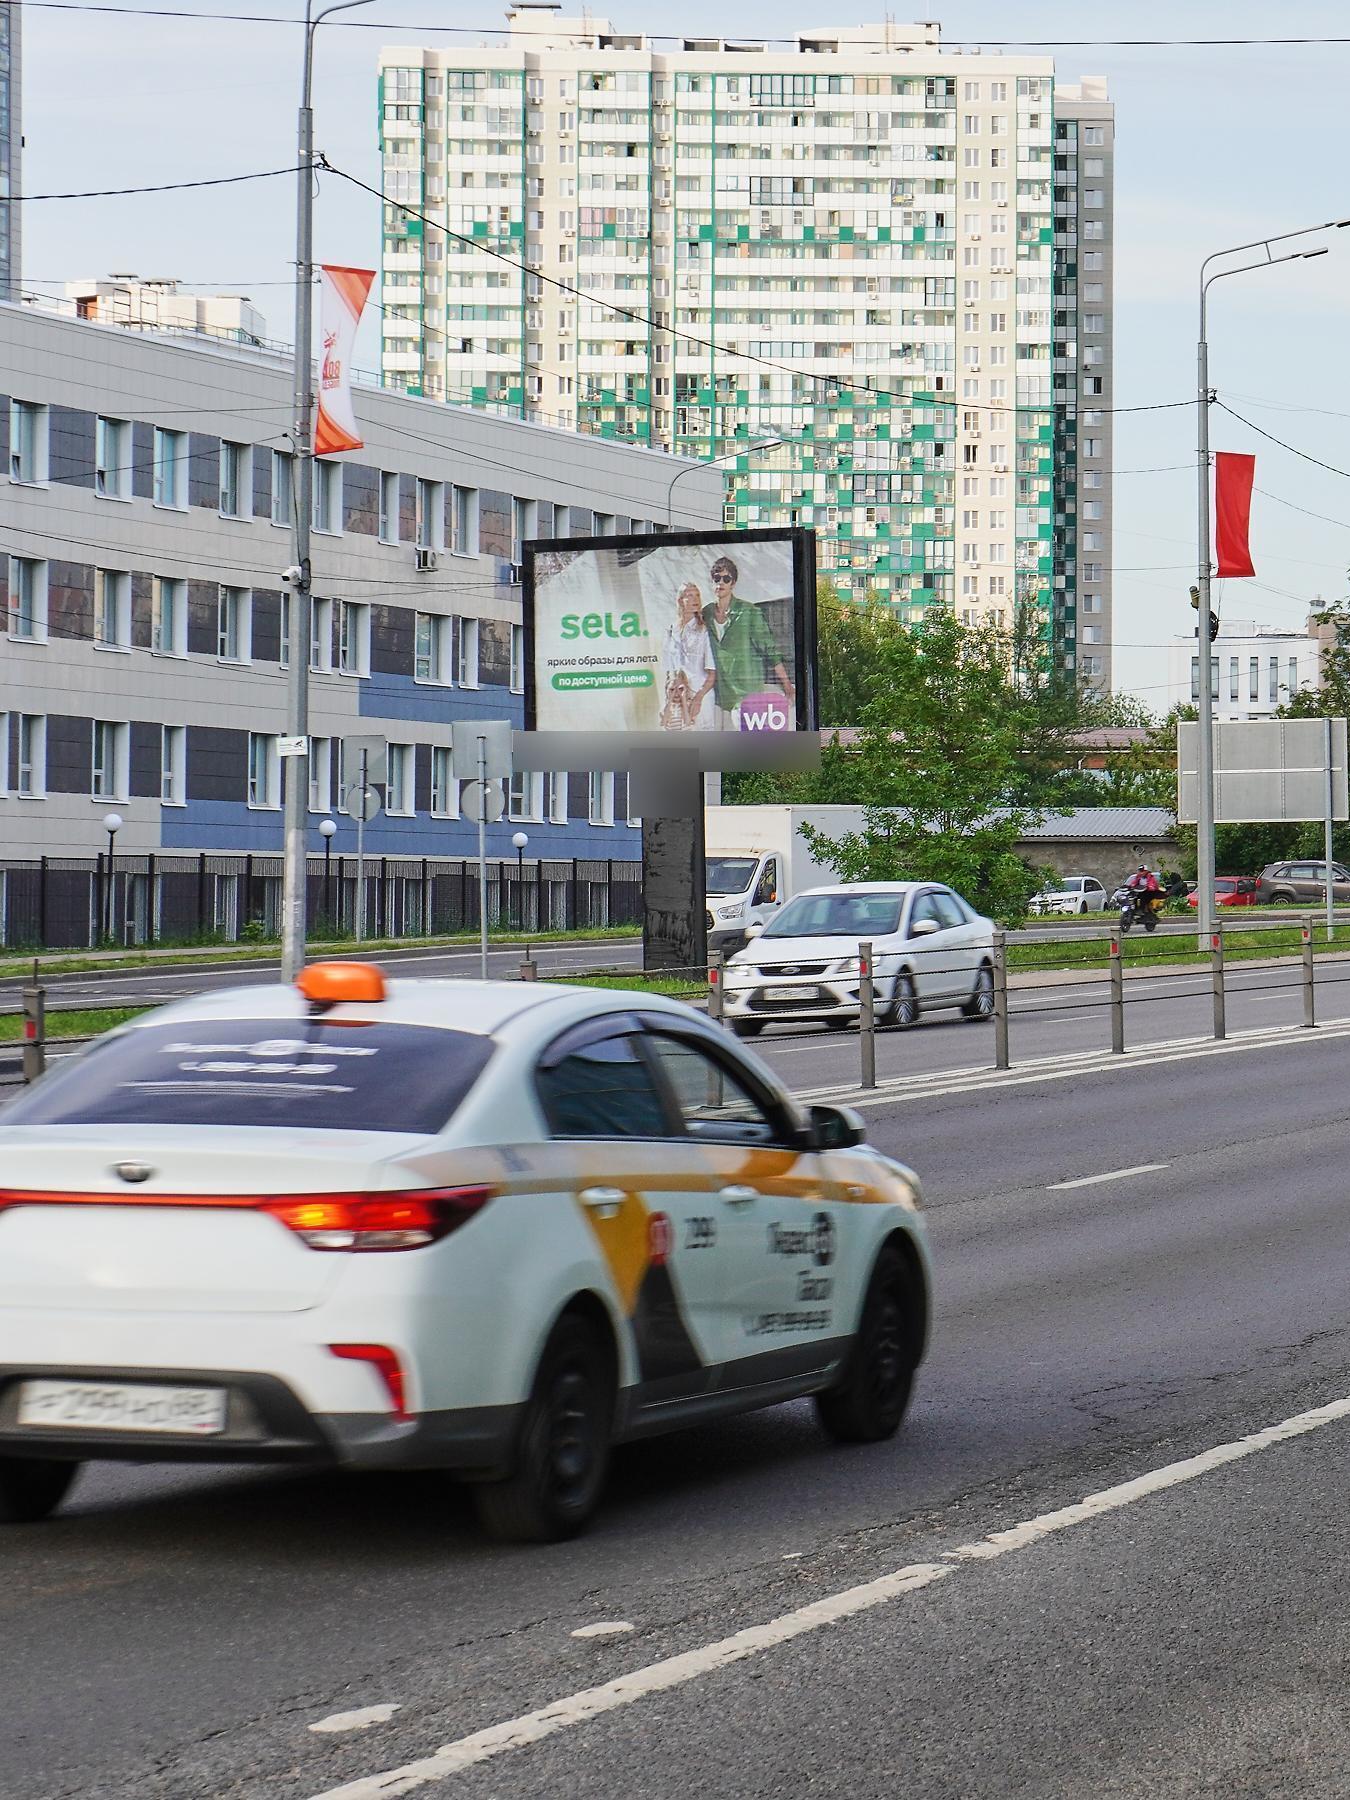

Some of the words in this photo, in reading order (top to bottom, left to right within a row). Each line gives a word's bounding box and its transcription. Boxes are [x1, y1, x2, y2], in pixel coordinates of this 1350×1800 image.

[560, 611, 649, 640] sela.
[547, 656, 577, 668] яркие
[578, 655, 615, 667] образы
[616, 656, 634, 665] для
[636, 655, 658, 664] лета
[559, 678, 571, 686] по
[572, 673, 623, 687] доступной
[624, 673, 648, 684] цене
[743, 703, 786, 731] wb
